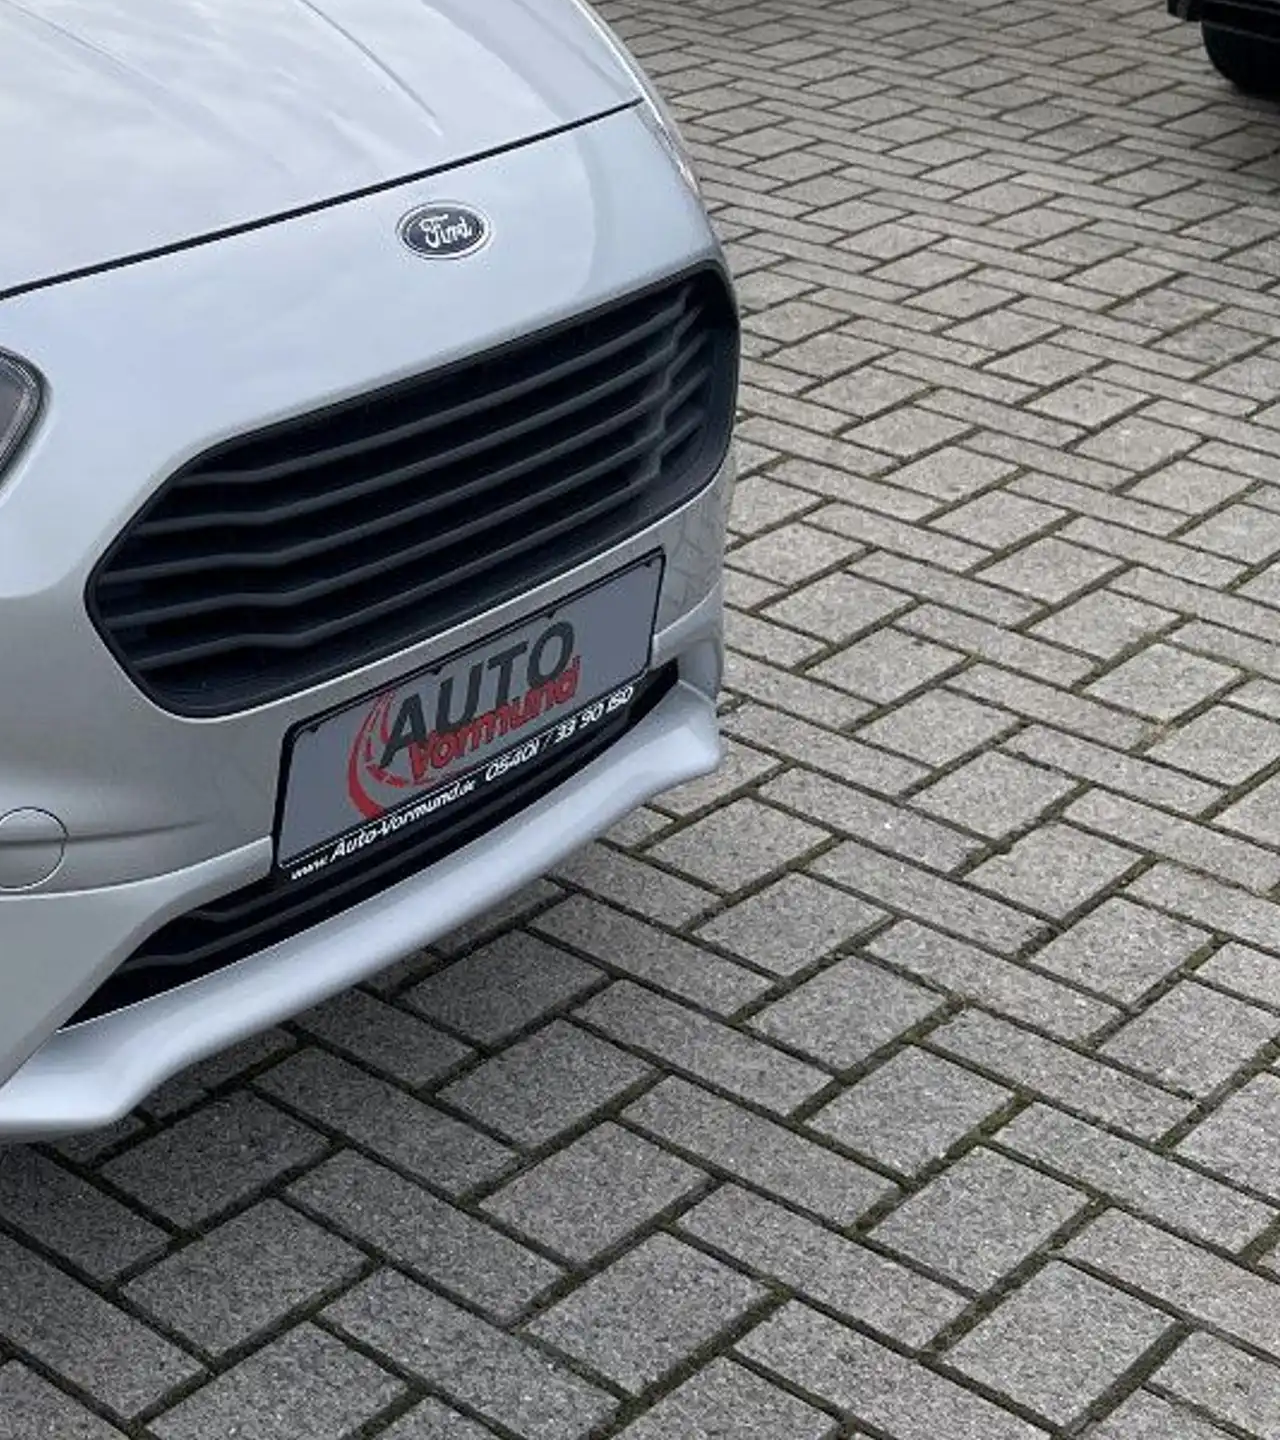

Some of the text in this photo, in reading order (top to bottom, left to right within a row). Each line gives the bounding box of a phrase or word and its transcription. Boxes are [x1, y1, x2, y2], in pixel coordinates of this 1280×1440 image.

[419, 214, 472, 248] Ford
[380, 621, 575, 769] AUTO
[408, 655, 581, 784] Vormund
